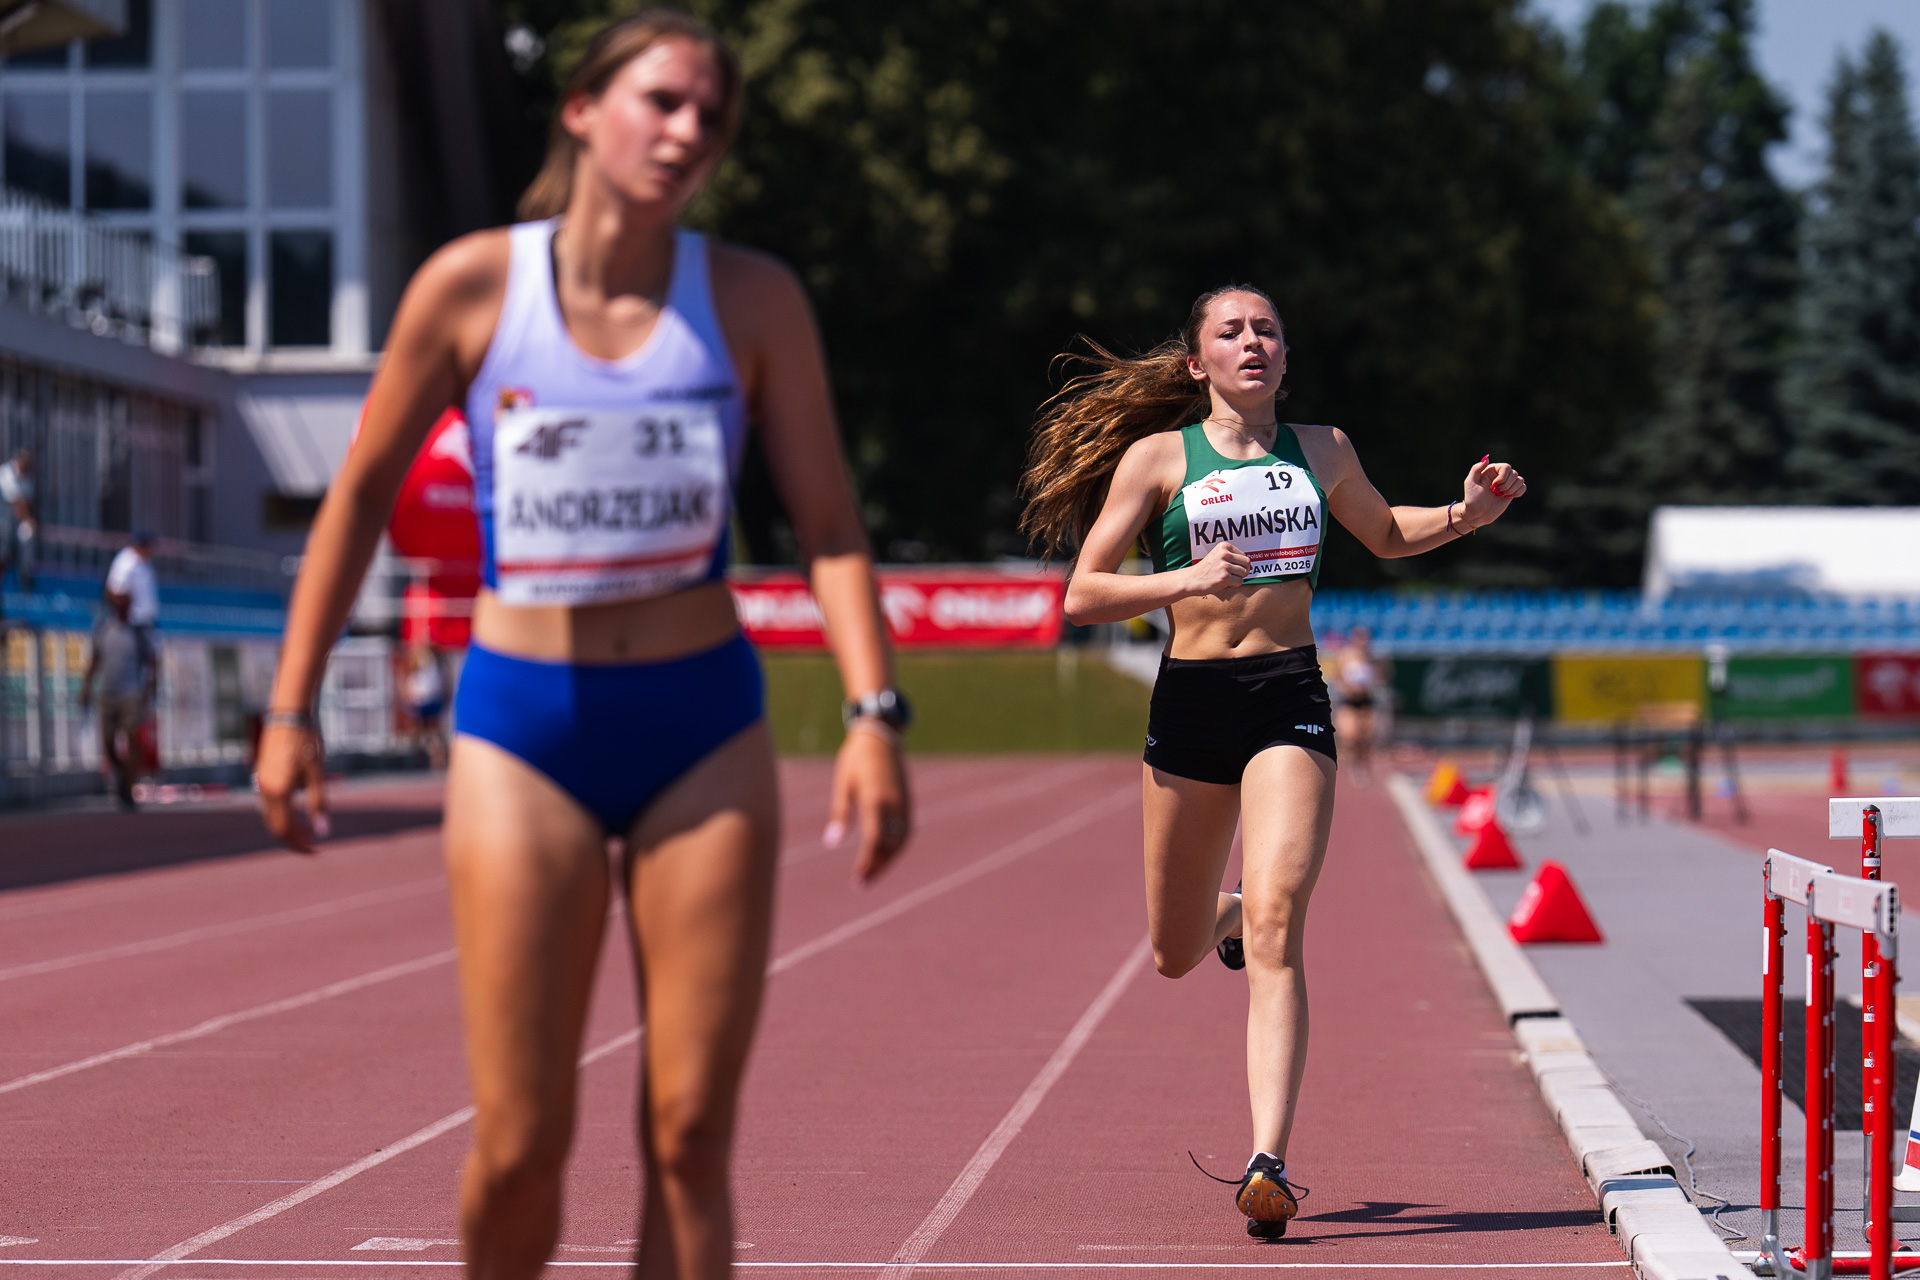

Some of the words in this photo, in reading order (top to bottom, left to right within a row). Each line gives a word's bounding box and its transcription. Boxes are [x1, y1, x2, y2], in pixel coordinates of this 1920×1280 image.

[1264, 471, 1293, 491] 19
[1201, 494, 1233, 506] ORLEN
[1194, 505, 1318, 546] KAMIŃSKA
[1284, 560, 1311, 571] 2026
